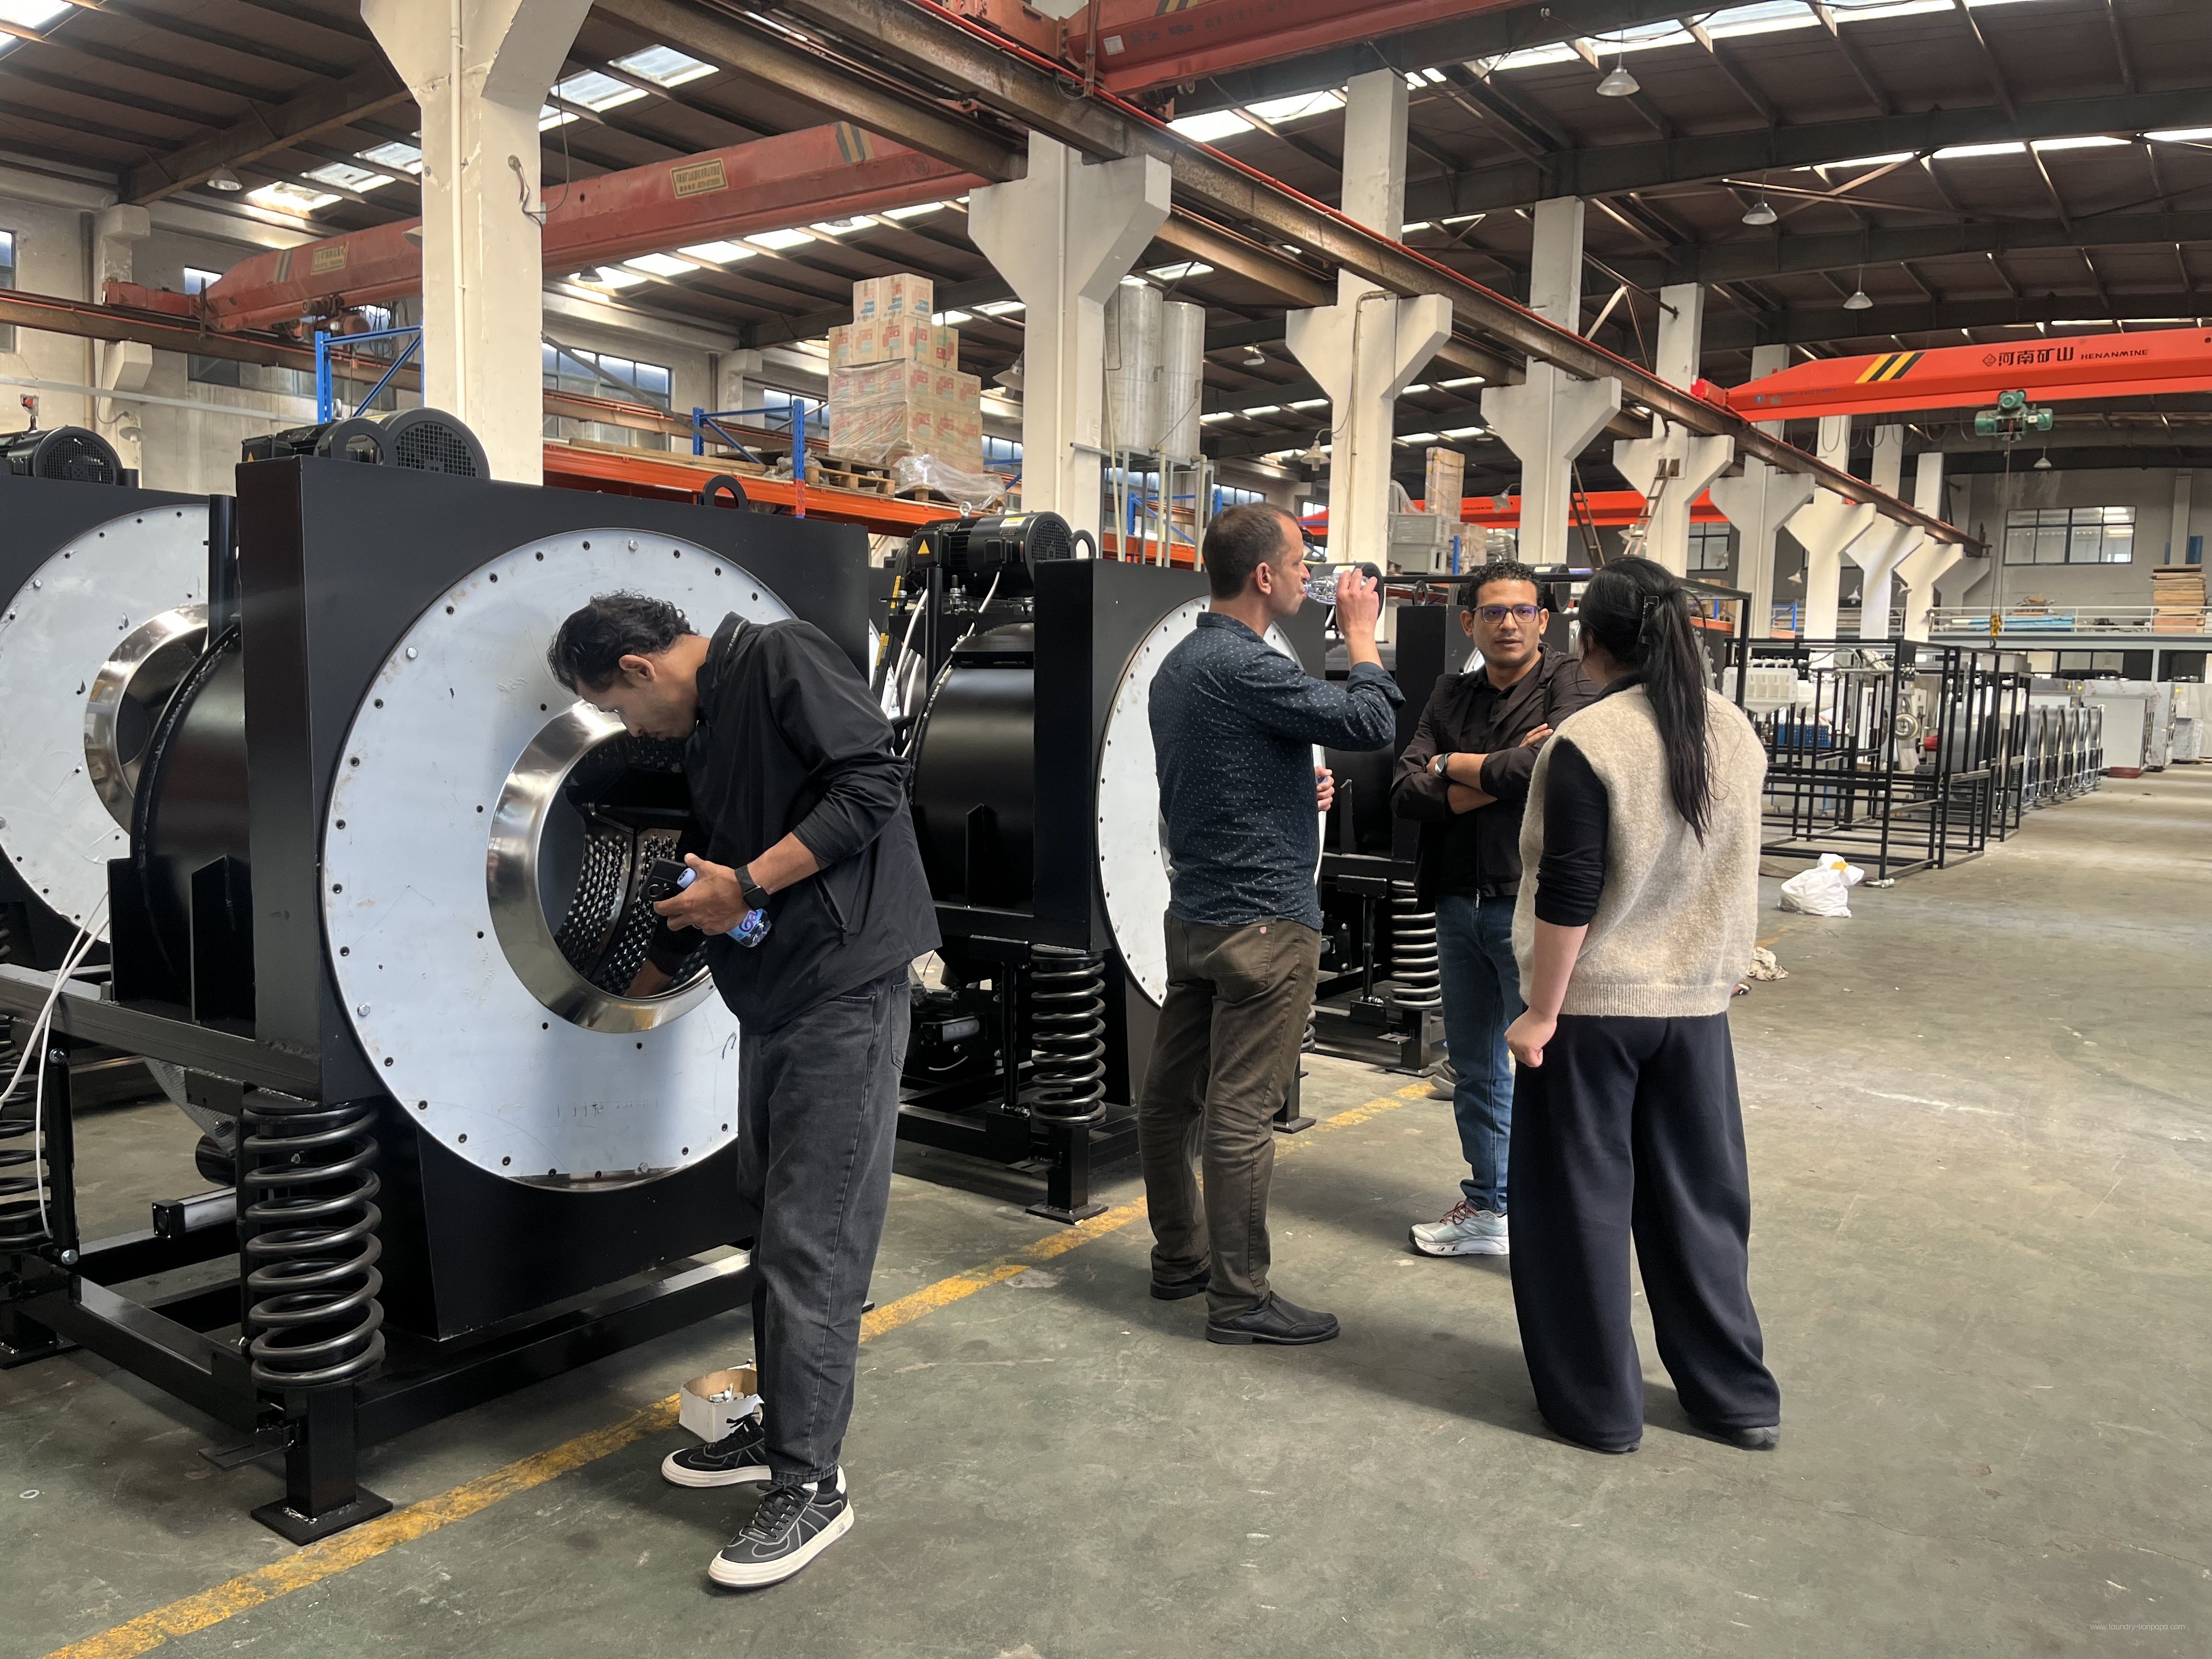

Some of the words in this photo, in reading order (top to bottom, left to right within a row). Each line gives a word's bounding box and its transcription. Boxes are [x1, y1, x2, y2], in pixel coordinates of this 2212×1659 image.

[1999, 347, 2074, 366] 河南矿山
[2080, 349, 2149, 360] HENANMINE
